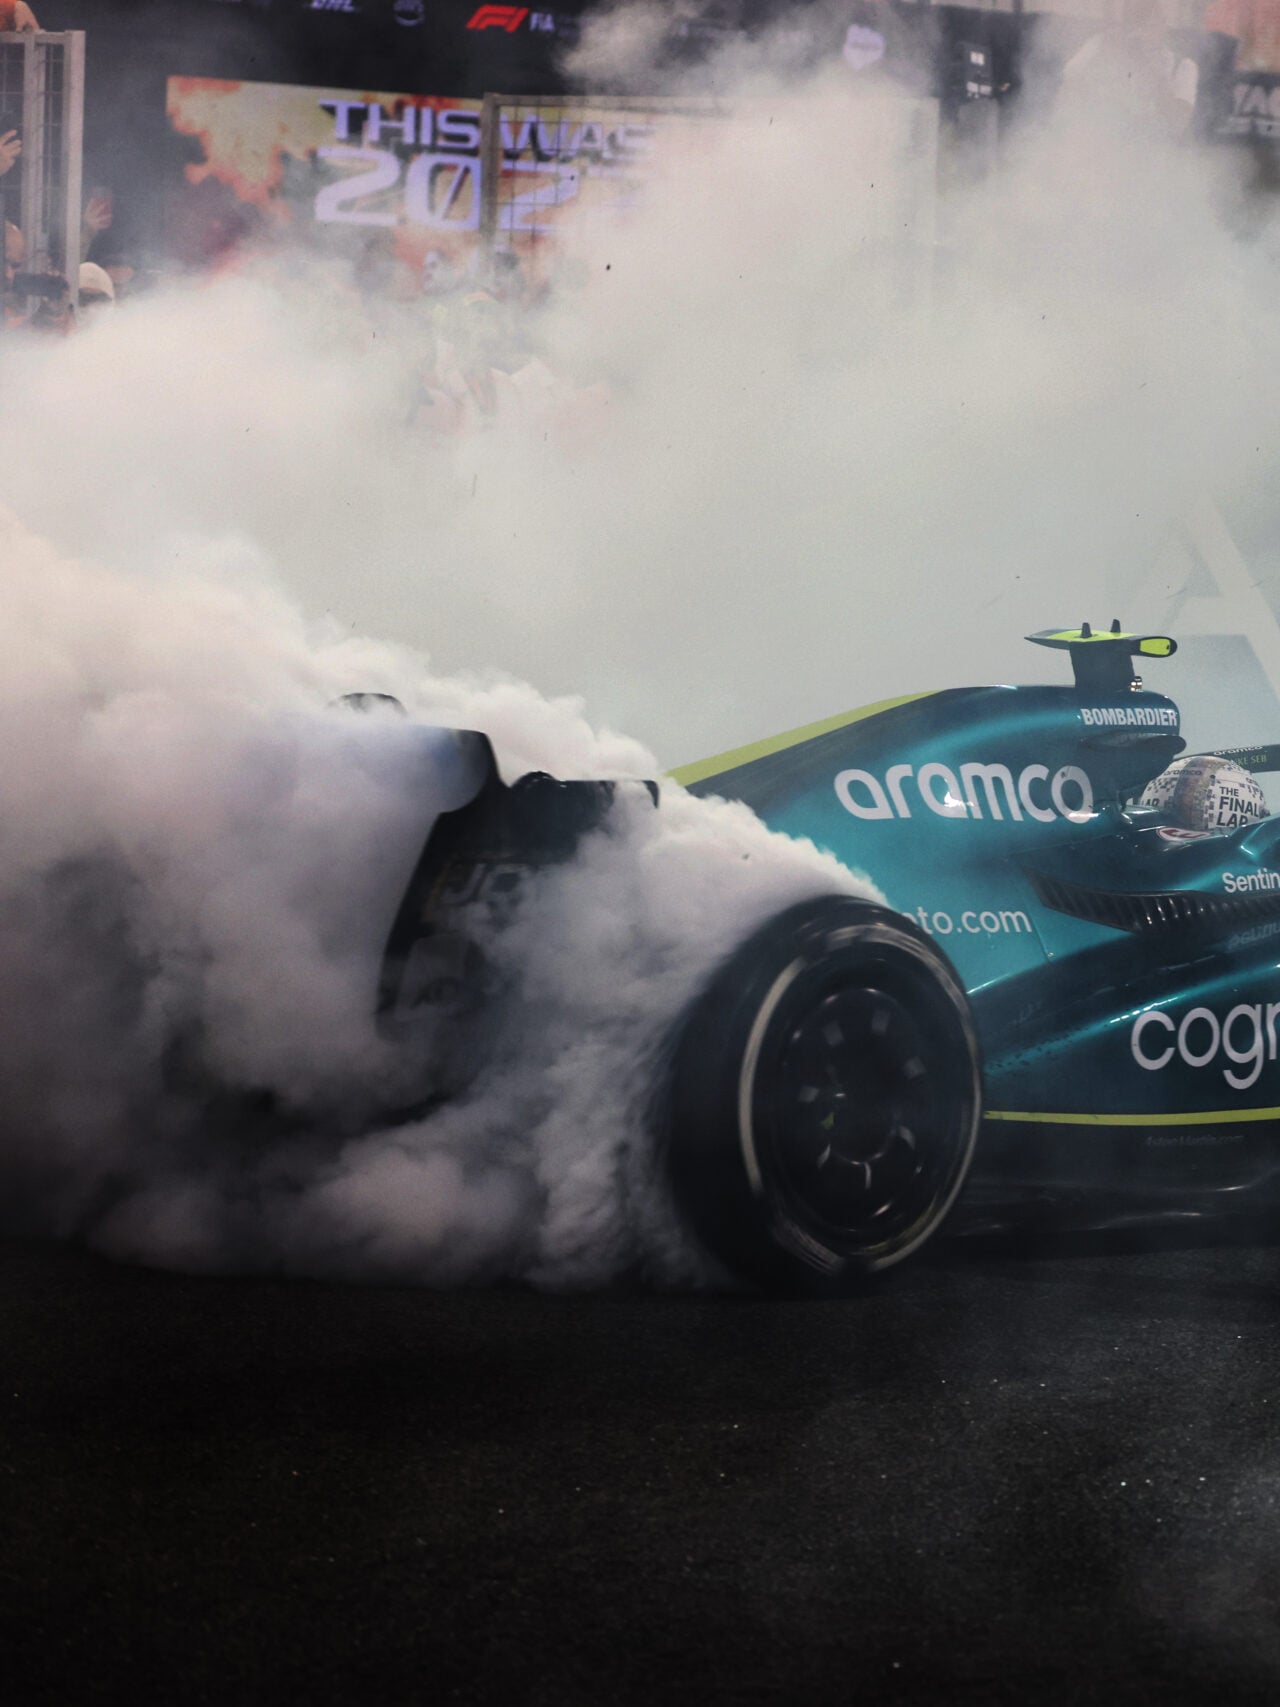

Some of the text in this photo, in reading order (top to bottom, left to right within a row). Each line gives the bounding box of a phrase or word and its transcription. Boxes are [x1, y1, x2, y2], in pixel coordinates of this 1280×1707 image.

[530, 12, 555, 32] FIA
[318, 98, 481, 149] THIS
[1081, 708, 1178, 726] BOMBARDIER
[834, 762, 1095, 824] aramco
[1219, 786, 1240, 797] THE
[1219, 795, 1260, 818] FINAL
